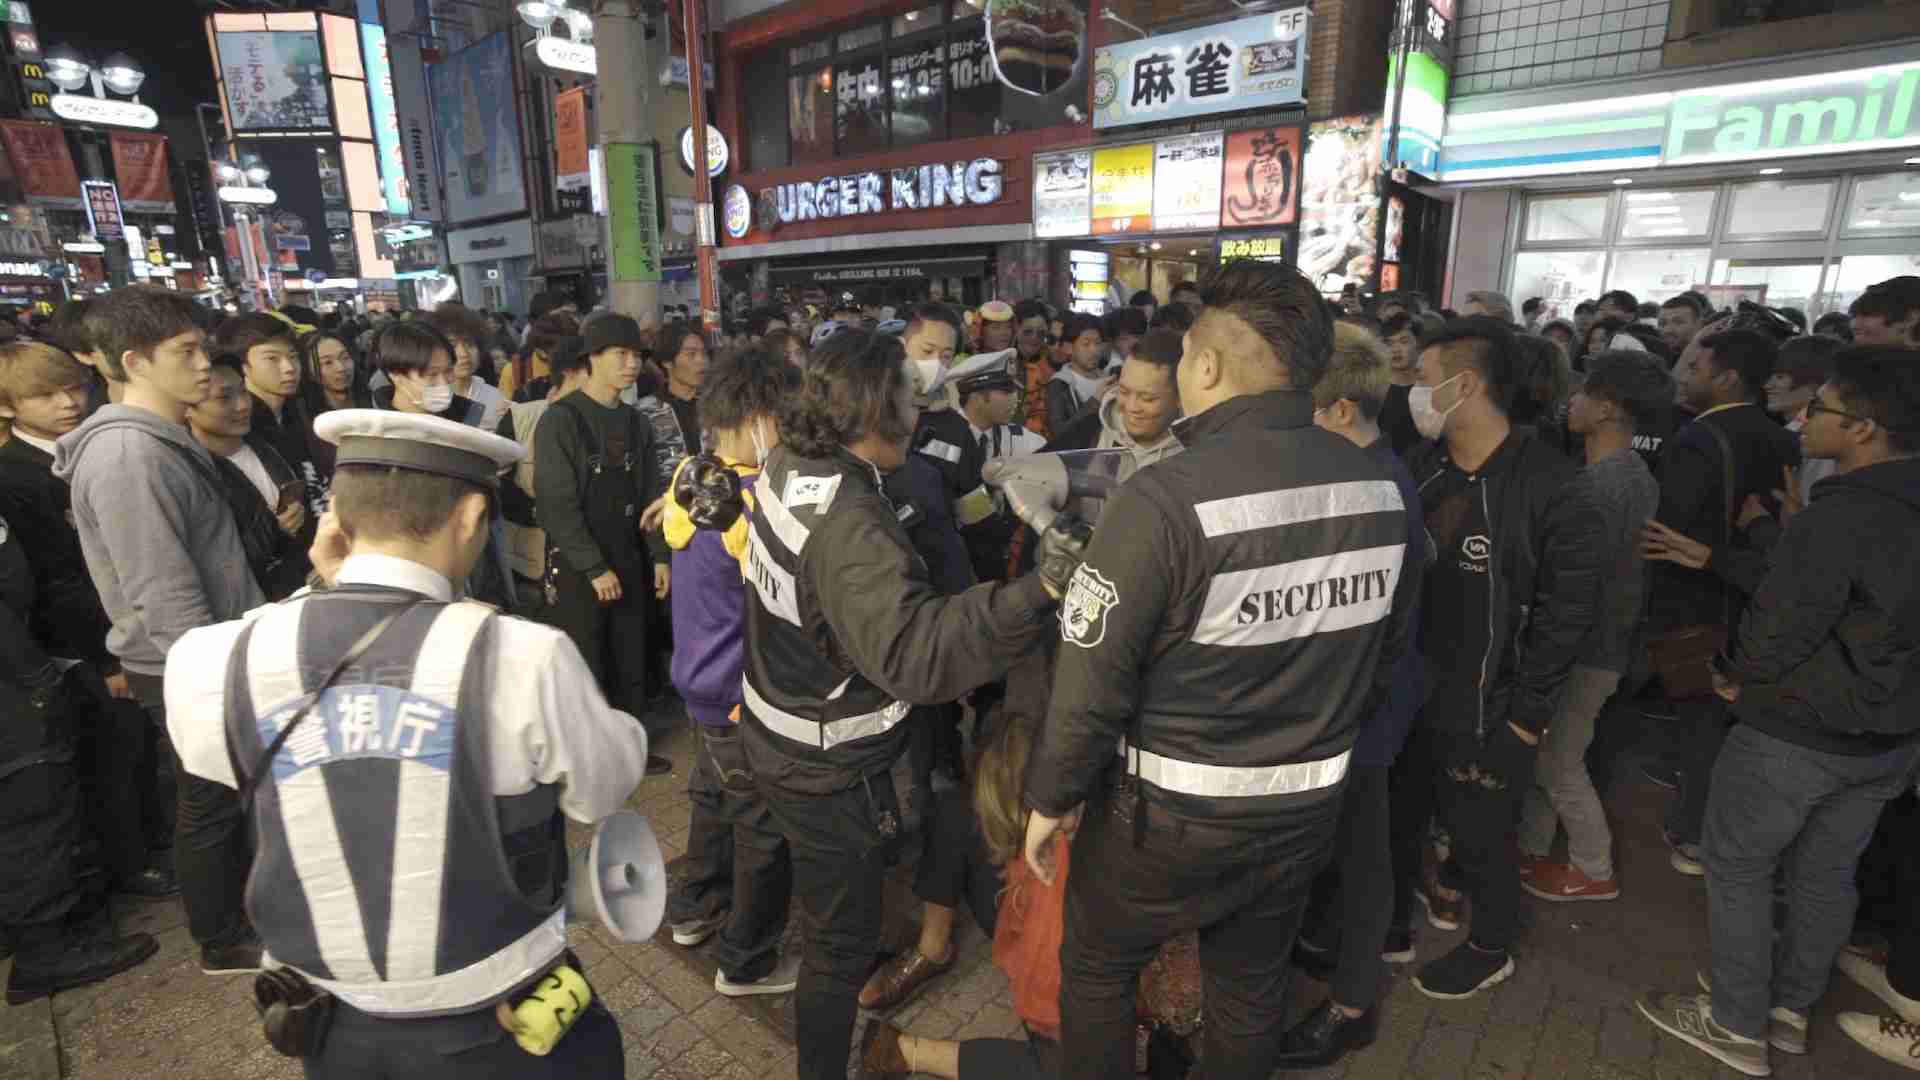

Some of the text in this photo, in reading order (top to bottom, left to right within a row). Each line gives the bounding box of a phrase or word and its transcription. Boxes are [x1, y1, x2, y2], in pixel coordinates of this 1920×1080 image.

[1131, 42, 1232, 107] 麻雀
[1666, 68, 1920, 161] Famil
[759, 171, 883, 232] BURGER
[891, 157, 1001, 209] KING
[1237, 567, 1391, 625] SECURITY
[270, 692, 442, 767] 警視庁
